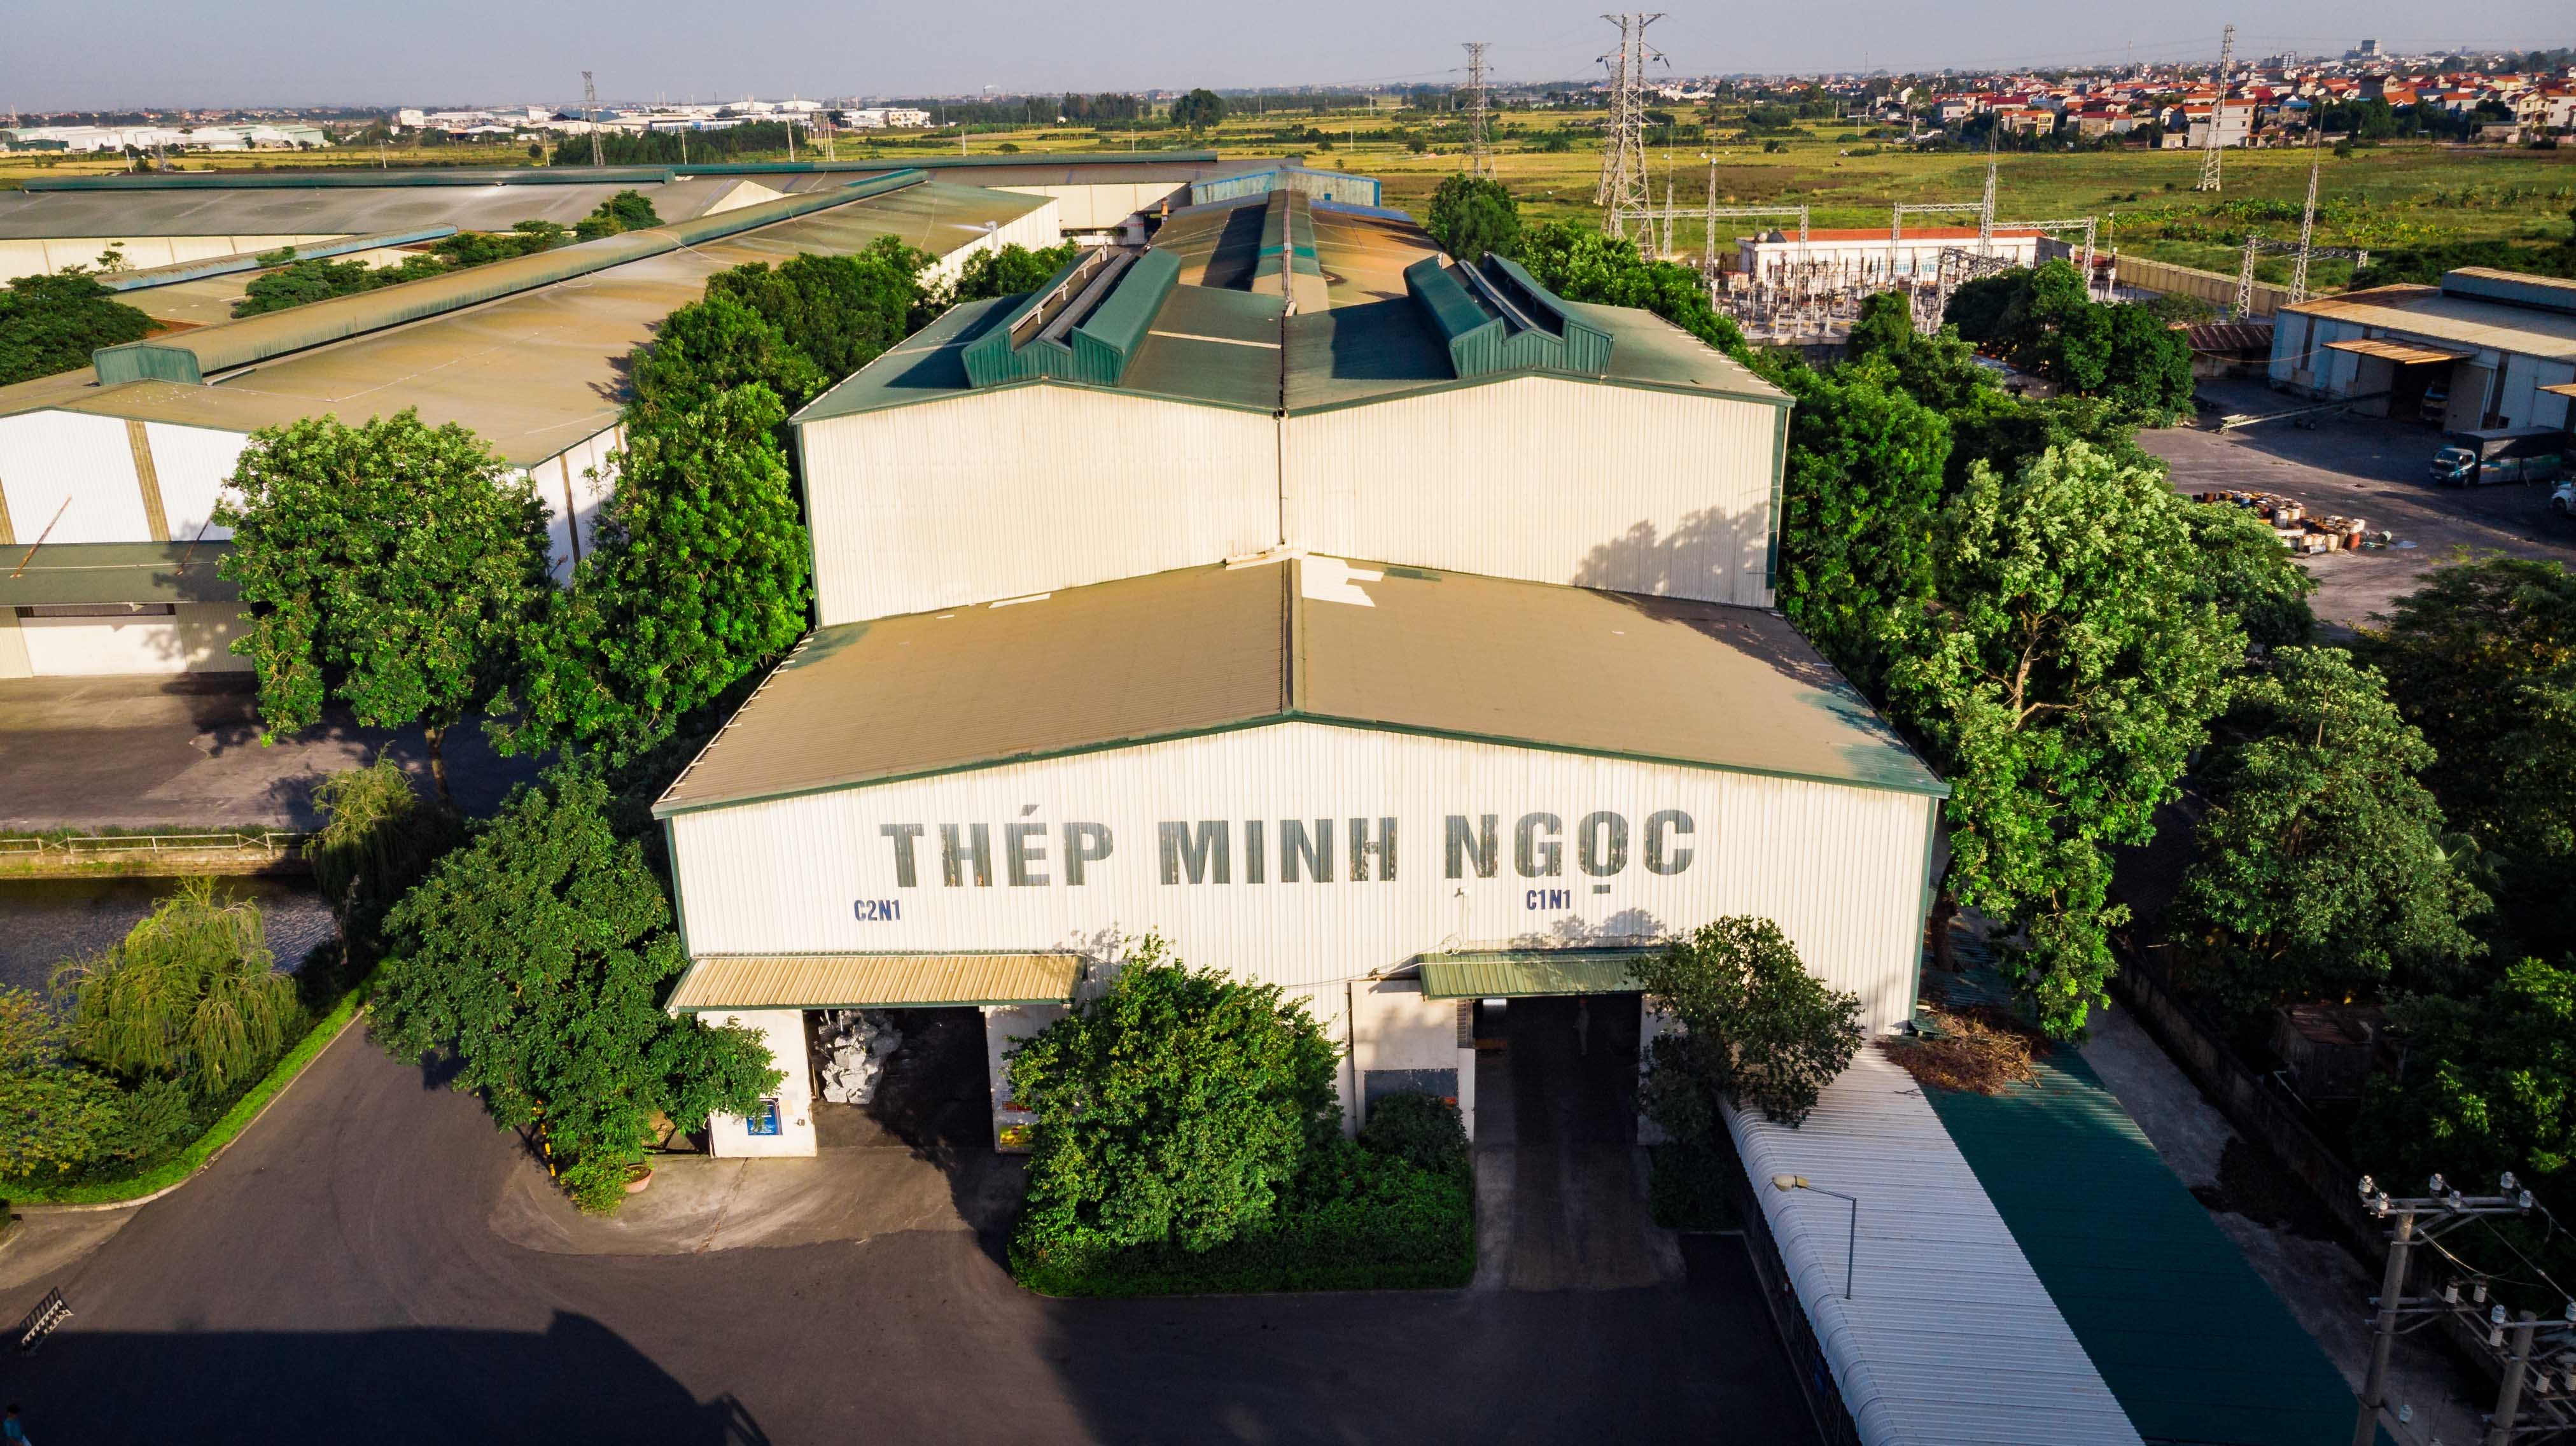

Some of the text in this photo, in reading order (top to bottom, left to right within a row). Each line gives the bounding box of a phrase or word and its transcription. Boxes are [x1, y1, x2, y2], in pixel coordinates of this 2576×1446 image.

[879, 804, 1694, 894] THÉP MINH NGỌC
[854, 899, 900, 922] C2N1
[1526, 889, 1571, 910] C1N1
